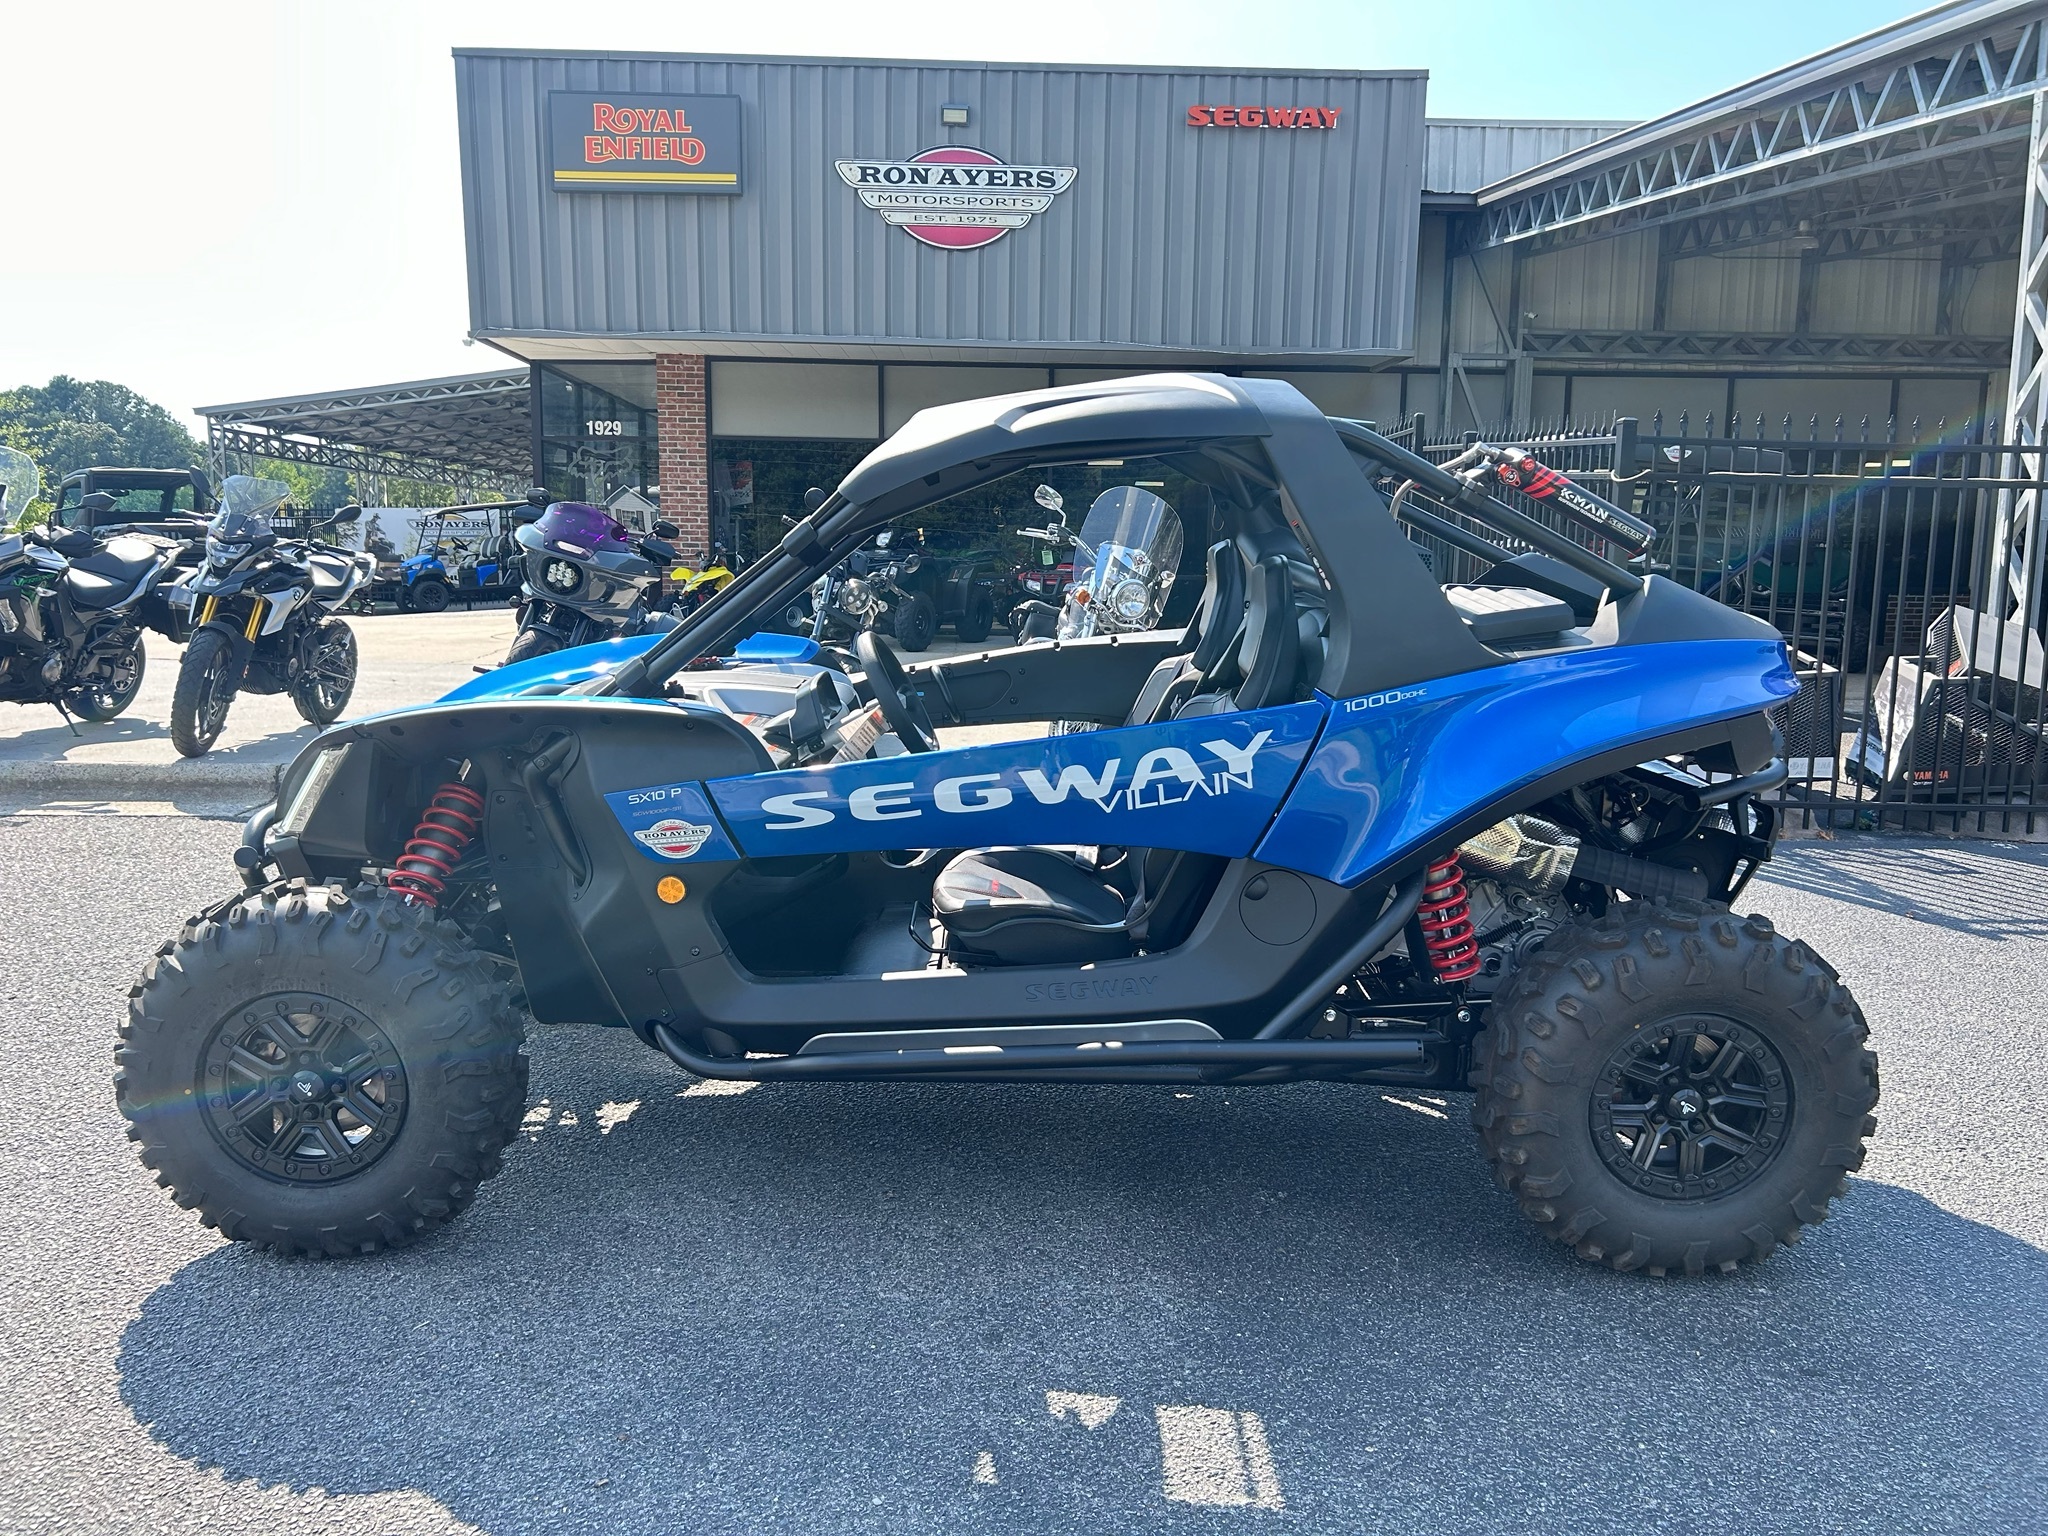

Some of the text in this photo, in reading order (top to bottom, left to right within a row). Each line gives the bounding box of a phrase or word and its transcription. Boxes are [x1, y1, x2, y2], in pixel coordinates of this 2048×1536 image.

[593, 102, 692, 135] ROYAL
[1187, 105, 1342, 128] SEGWAY
[584, 135, 706, 166] ENFIELD
[856, 165, 1057, 189] RON AYERS
[877, 194, 1034, 208] MOTORSPORTS
[914, 214, 998, 224] EST. 1975
[586, 420, 622, 436] 1929
[761, 729, 1274, 830] SEGWAY
[1913, 770, 1949, 781] YAMHA
[628, 787, 682, 805] SX10 P
[1095, 769, 1254, 814] VILLAIN
[643, 829, 706, 839] RON AYERS
[1024, 975, 1159, 1003] SEGWAY
